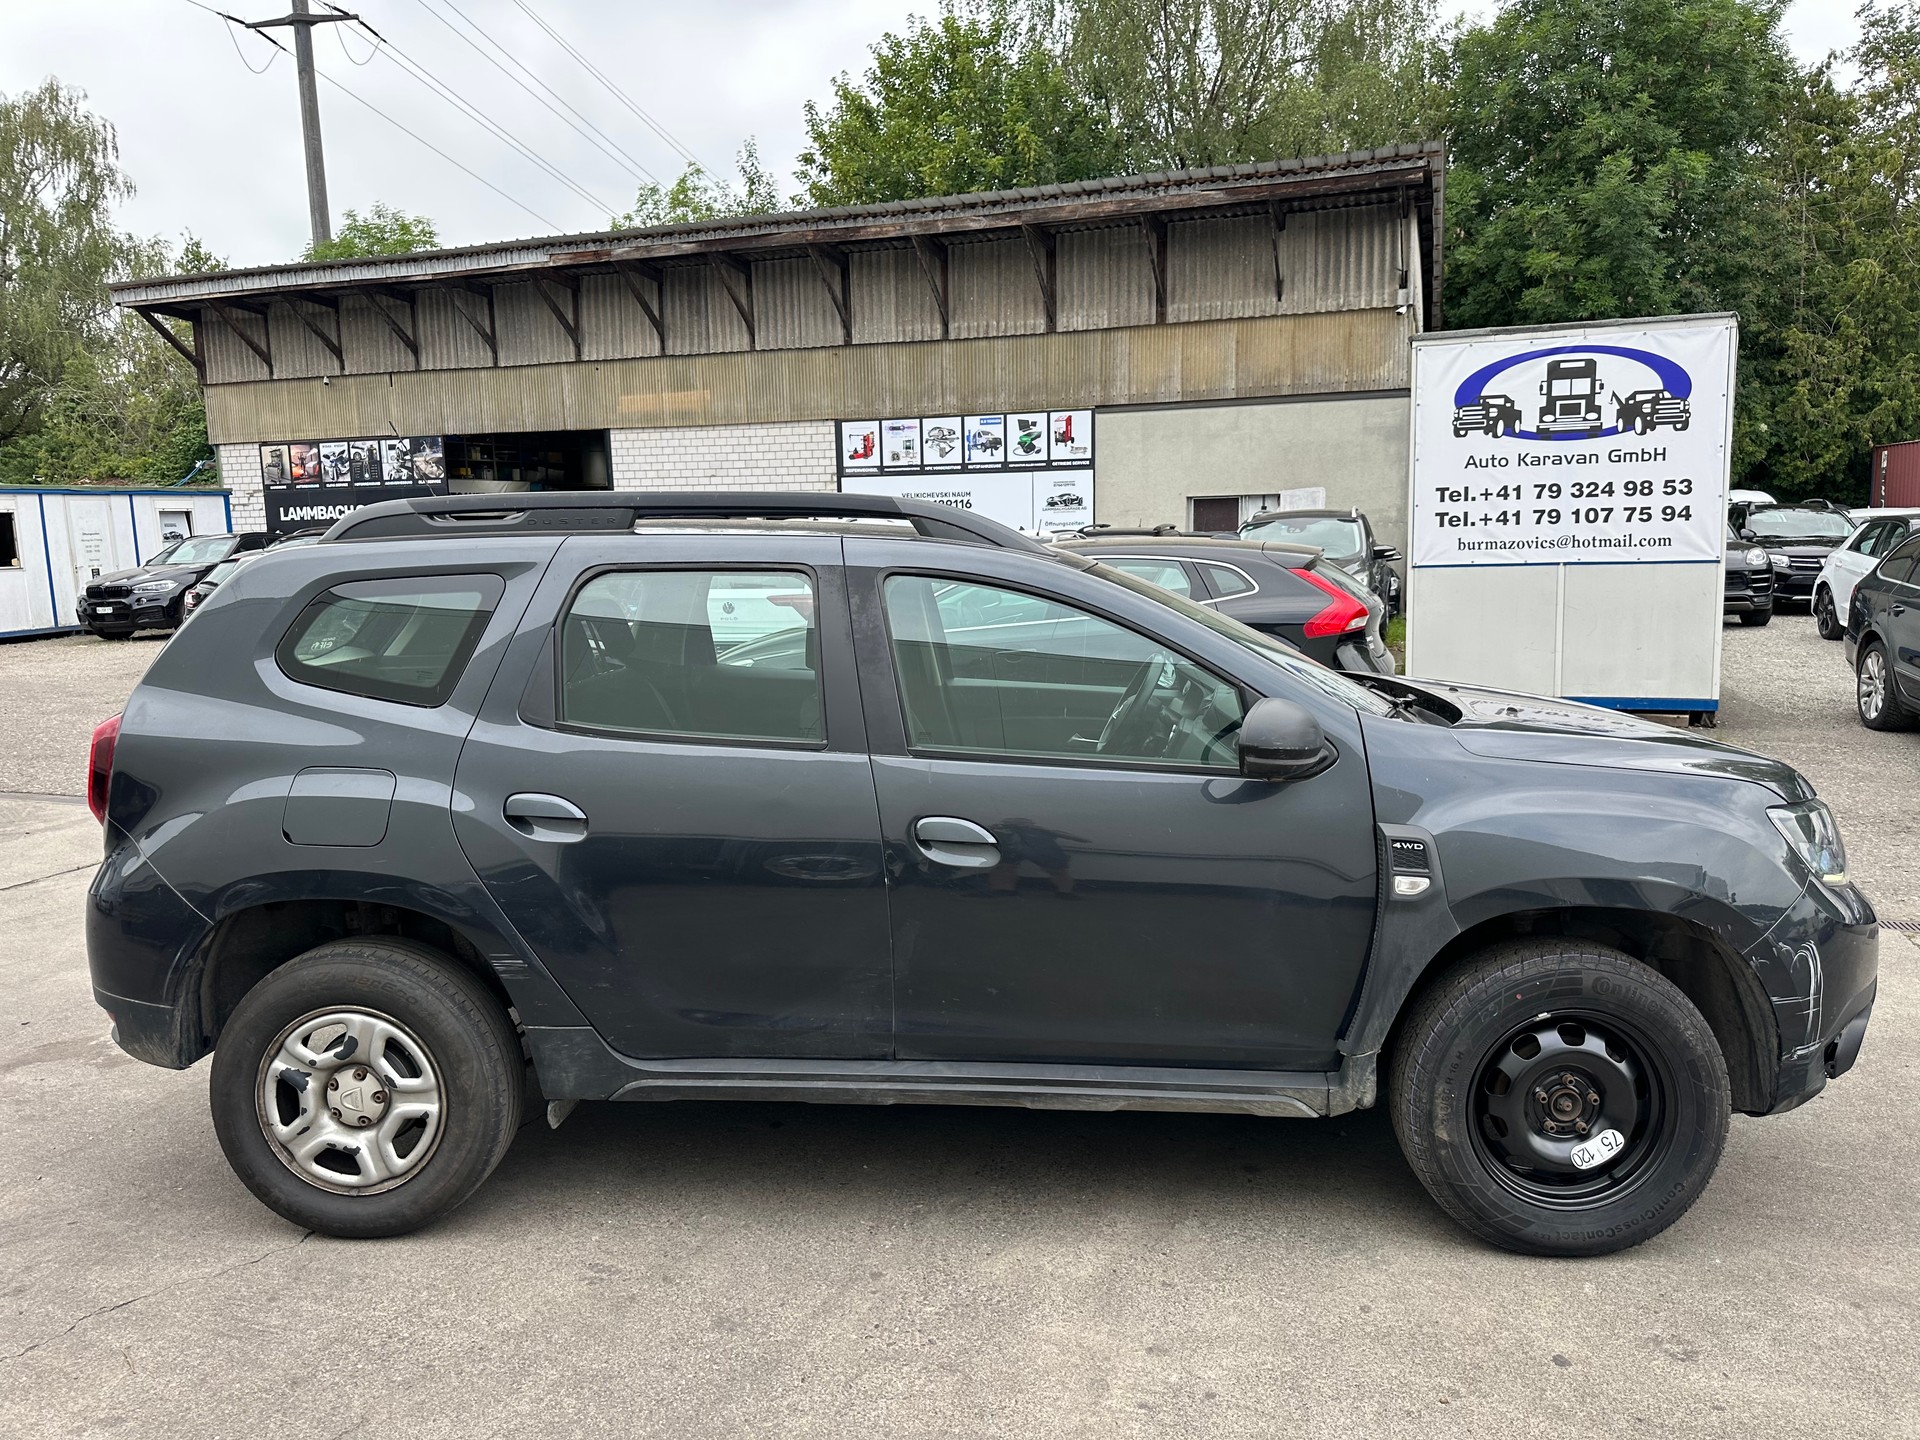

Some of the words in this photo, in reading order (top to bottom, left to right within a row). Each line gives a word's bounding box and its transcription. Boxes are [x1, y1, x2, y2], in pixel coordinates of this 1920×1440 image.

[1465, 455, 1509, 469] Auto
[1518, 453, 1599, 467] Karavan
[1608, 447, 1667, 463] GmbH
[1435, 485, 1522, 502] Tel.+41
[1533, 483, 1562, 499] 79
[1571, 481, 1615, 498] 324
[1623, 480, 1654, 497] 98
[1662, 479, 1692, 496] 53
[279, 504, 361, 521] LAMMBACH
[527, 516, 616, 526] DUSTER
[1435, 510, 1521, 527] Tel.+41
[1532, 509, 1562, 525] 79
[1571, 508, 1614, 524] 107
[1623, 507, 1653, 523] 75
[1661, 506, 1692, 522] 94
[1457, 534, 1672, 551] burmazovics@hotmail.com
[1392, 842, 1424, 850] 4WD
[1600, 1131, 1623, 1152] 75
[1572, 1147, 1595, 1167] 120
